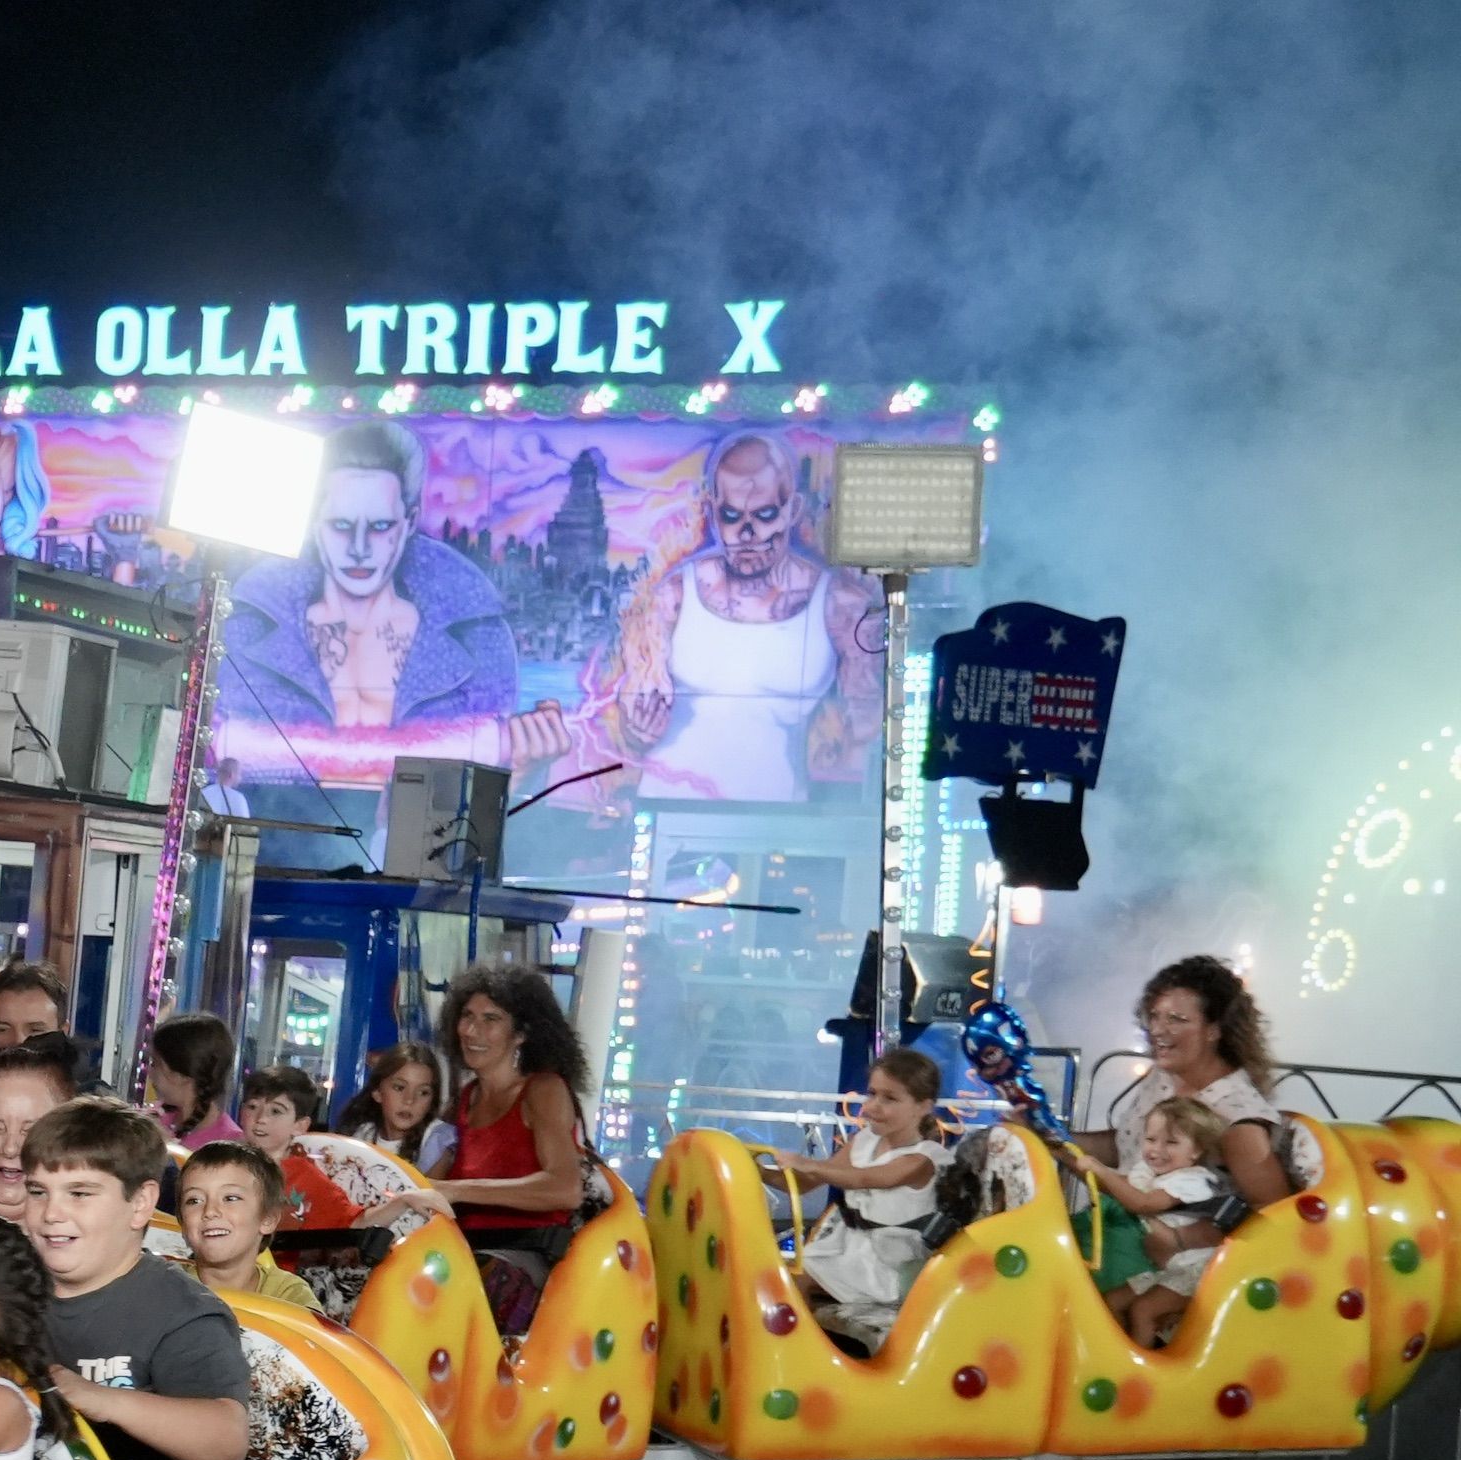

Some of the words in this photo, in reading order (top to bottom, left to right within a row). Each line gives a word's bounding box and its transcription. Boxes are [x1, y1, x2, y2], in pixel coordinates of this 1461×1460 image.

[94, 303, 307, 377] OLLA
[345, 301, 667, 376] TRIPLE
[720, 300, 786, 376] X
[76, 1355, 133, 1383] THE
